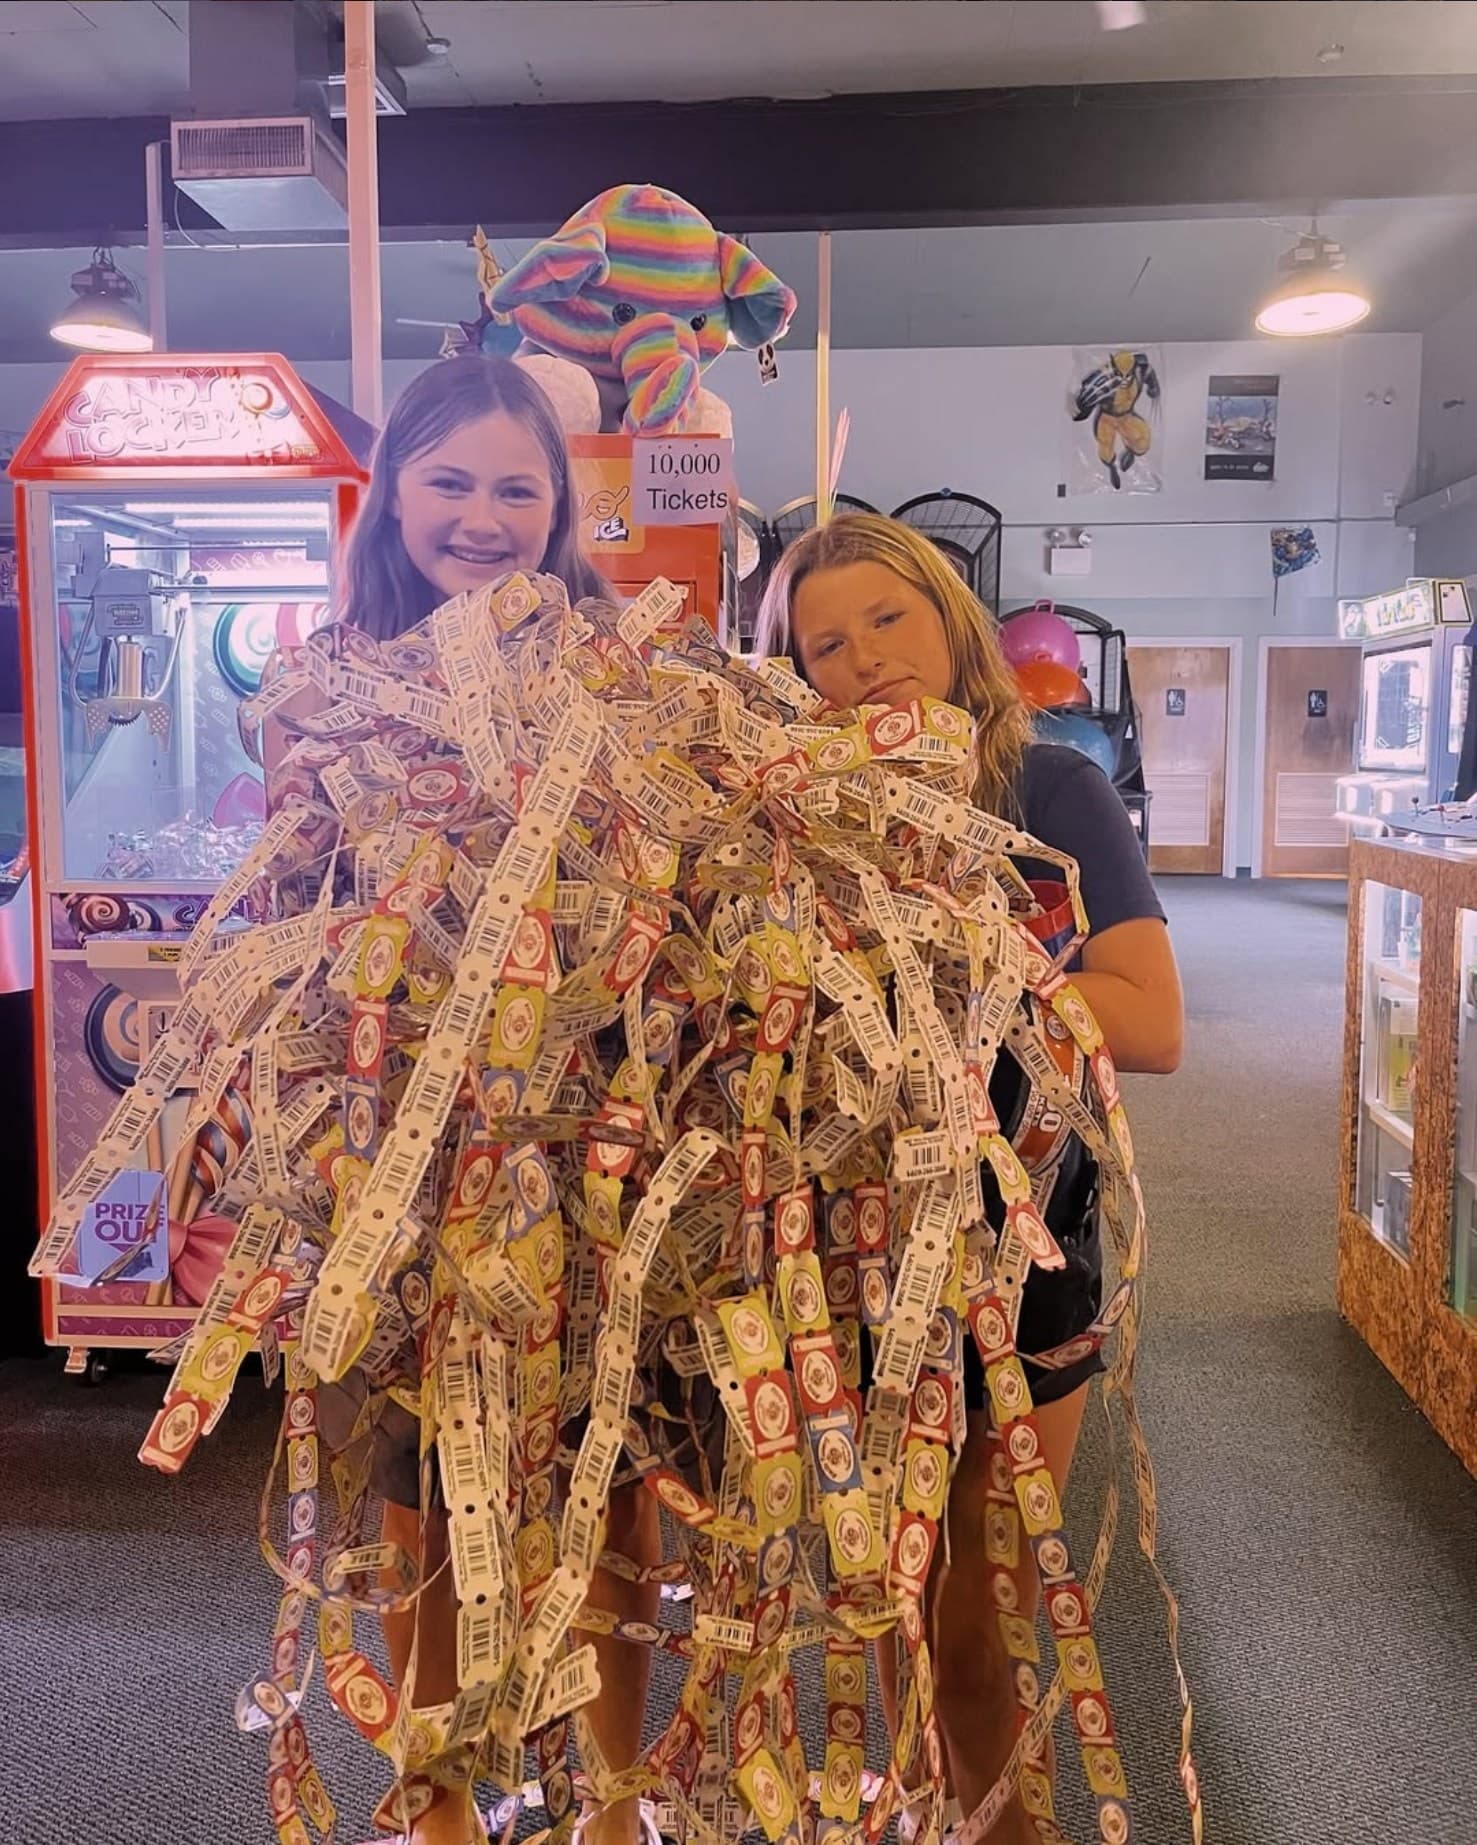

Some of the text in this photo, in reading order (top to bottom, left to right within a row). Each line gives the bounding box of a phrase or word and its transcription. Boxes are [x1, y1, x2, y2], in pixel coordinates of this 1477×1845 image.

[65, 367, 220, 427] CANDY
[66, 408, 239, 463] LOCKER
[649, 453, 720, 478] 10,000
[647, 488, 728, 510] Tickets
[593, 516, 628, 541] ICE
